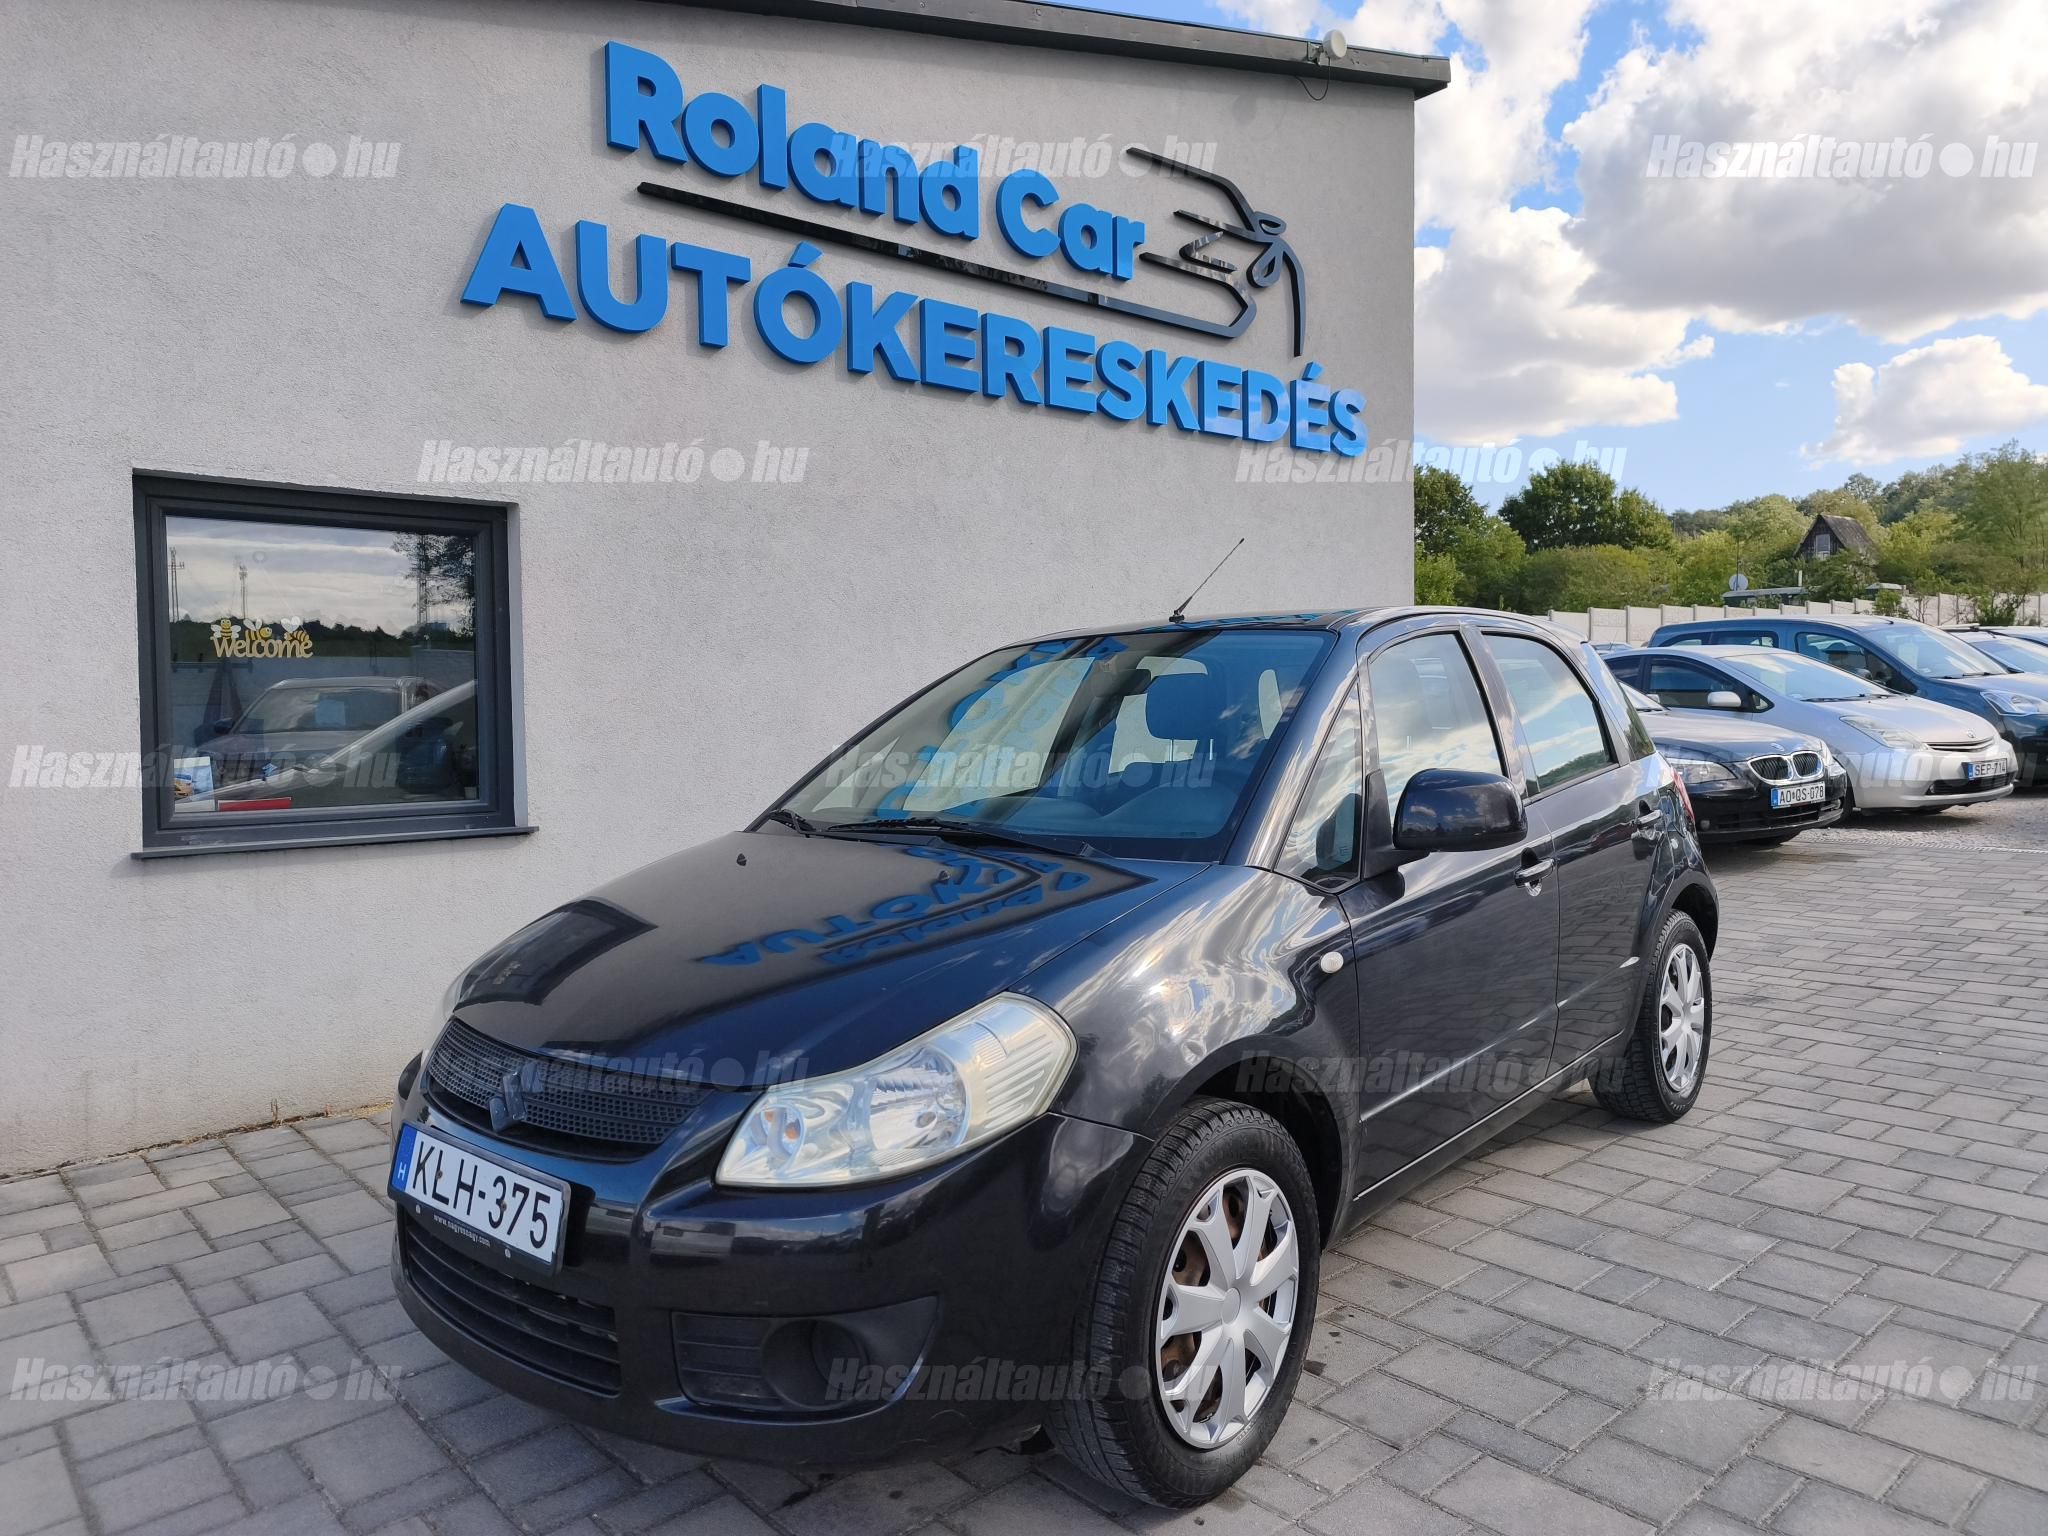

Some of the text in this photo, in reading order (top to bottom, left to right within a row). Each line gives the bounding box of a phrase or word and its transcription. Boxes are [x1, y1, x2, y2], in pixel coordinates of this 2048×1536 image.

[604, 41, 1147, 282] Roland Car
[460, 203, 1368, 458] AUTÓKERESKEDÉS
[397, 1140, 551, 1250] H KLH-375
